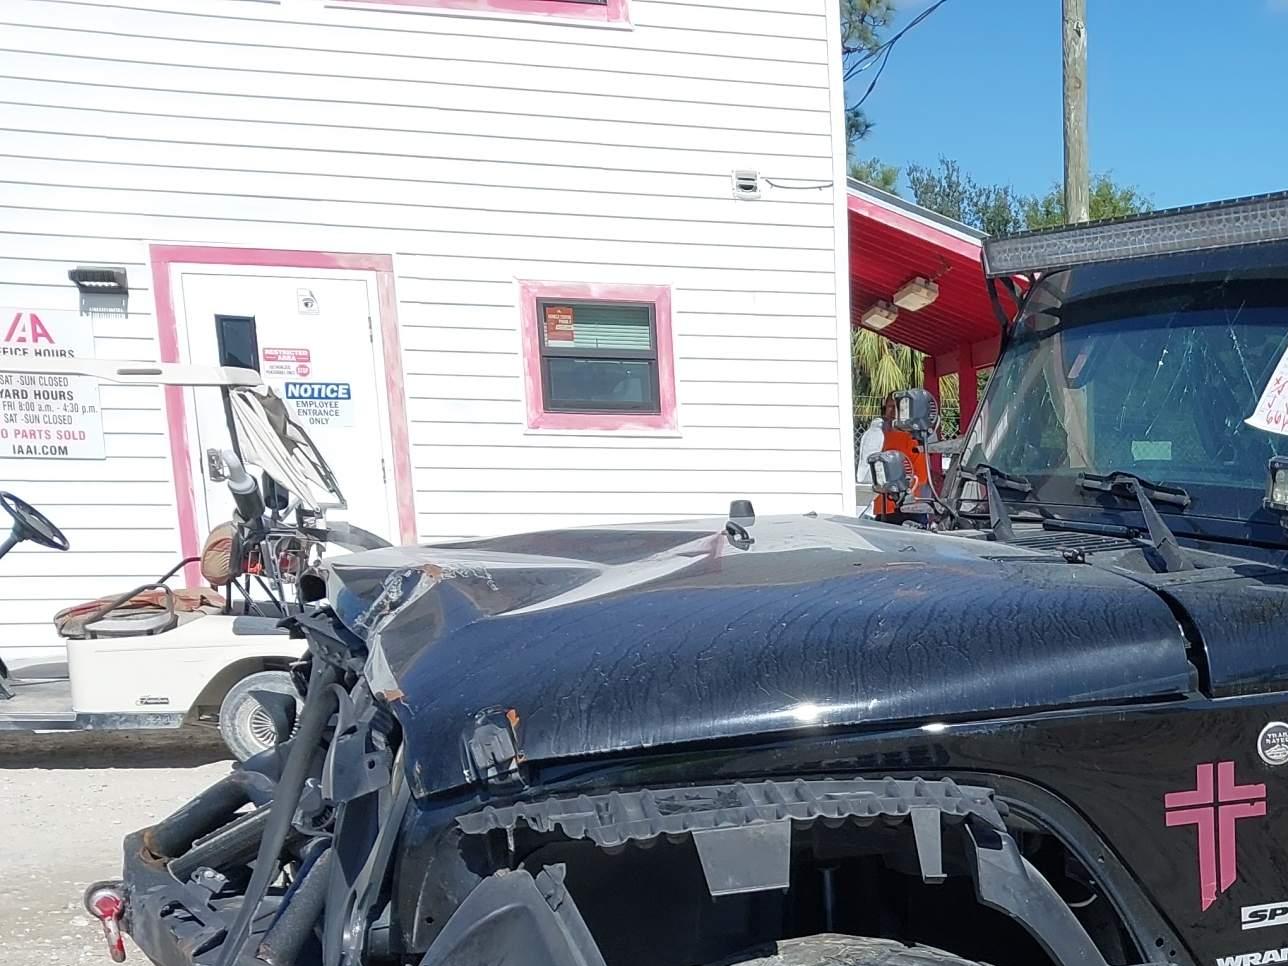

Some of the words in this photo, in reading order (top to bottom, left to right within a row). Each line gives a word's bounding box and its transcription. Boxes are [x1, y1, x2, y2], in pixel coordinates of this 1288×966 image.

[0, 375, 13, 385] SAT
[39, 376, 69, 387] CLOSED
[34, 390, 74, 401] HOURS
[288, 384, 350, 398] NOTICE
[2, 401, 16, 411] FRI
[18, 401, 35, 412] 8:00
[38, 403, 54, 412] a.m.
[63, 403, 79, 413] 4:30
[82, 405, 99, 415] p.m.
[296, 401, 340, 409] EMPLOYEE
[4, 413, 18, 424] SAT
[43, 415, 73, 425] CLOSED
[298, 409, 341, 417] ENTRANCE
[14, 429, 52, 440] PARTS
[57, 431, 86, 441] SOLD
[12, 444, 69, 456] IAAI.COM
